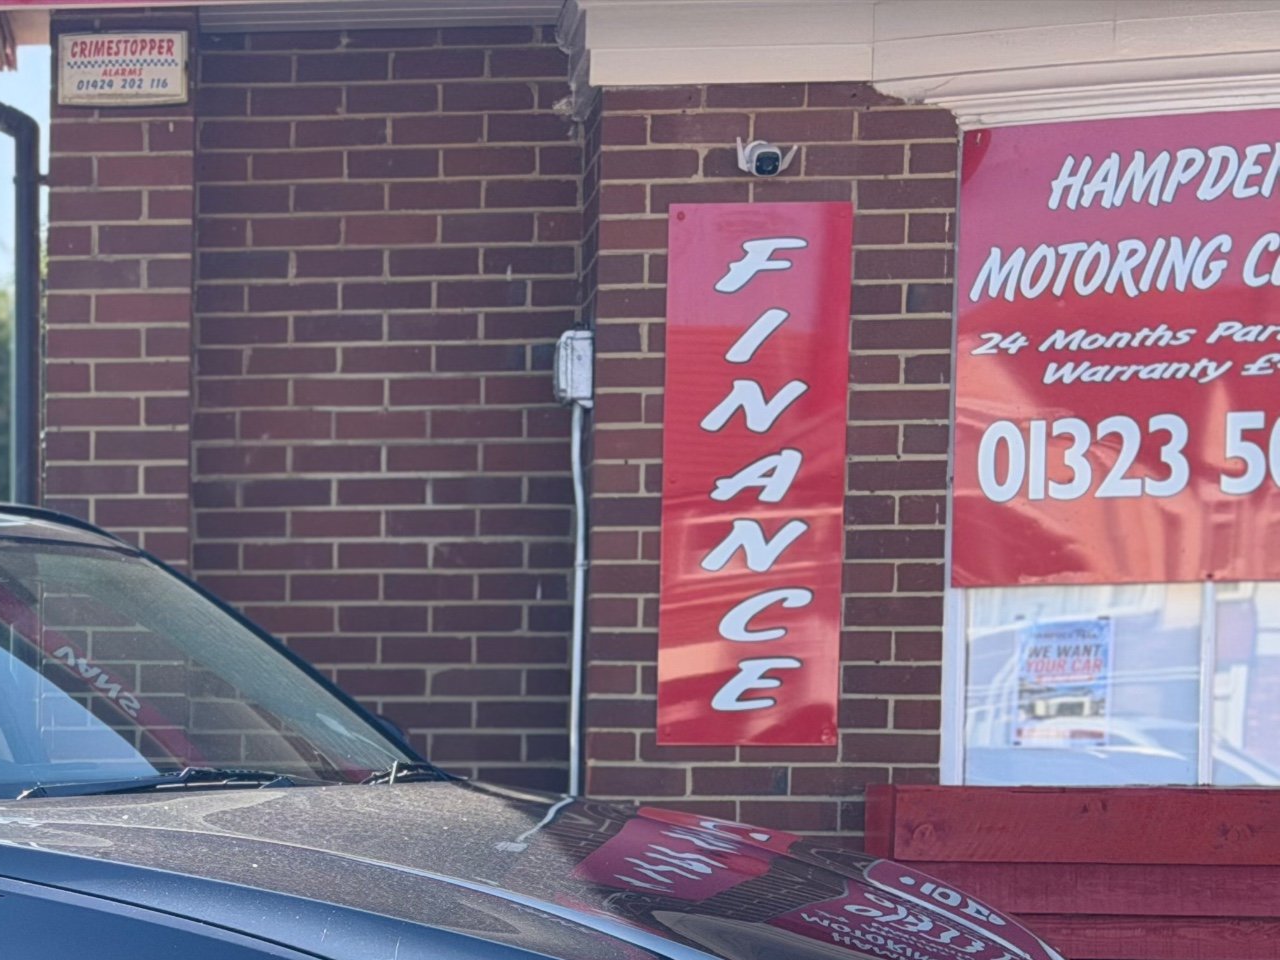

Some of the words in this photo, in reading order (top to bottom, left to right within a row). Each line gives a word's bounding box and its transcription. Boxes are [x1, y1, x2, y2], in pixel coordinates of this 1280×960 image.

[71, 38, 175, 58] CRIMESTOPPER
[102, 67, 144, 77] ALARMS
[76, 79, 114, 90] 01424
[121, 78, 144, 89] 202
[150, 78, 168, 88] 116
[969, 233, 1233, 302] MOTORING
[1242, 232, 1280, 287] C
[970, 331, 1029, 356] 24
[1038, 323, 1197, 353] Months
[1205, 320, 1280, 344] Par
[1043, 358, 1232, 384] Warranty
[977, 413, 1191, 503] 01323
[1220, 410, 1280, 495] 5
[700, 237, 813, 711] FINANCE
[1028, 645, 1052, 659] WE
[1056, 643, 1102, 659] WANT
[1026, 659, 1066, 673] YOUR
[1071, 658, 1103, 673] CAR
